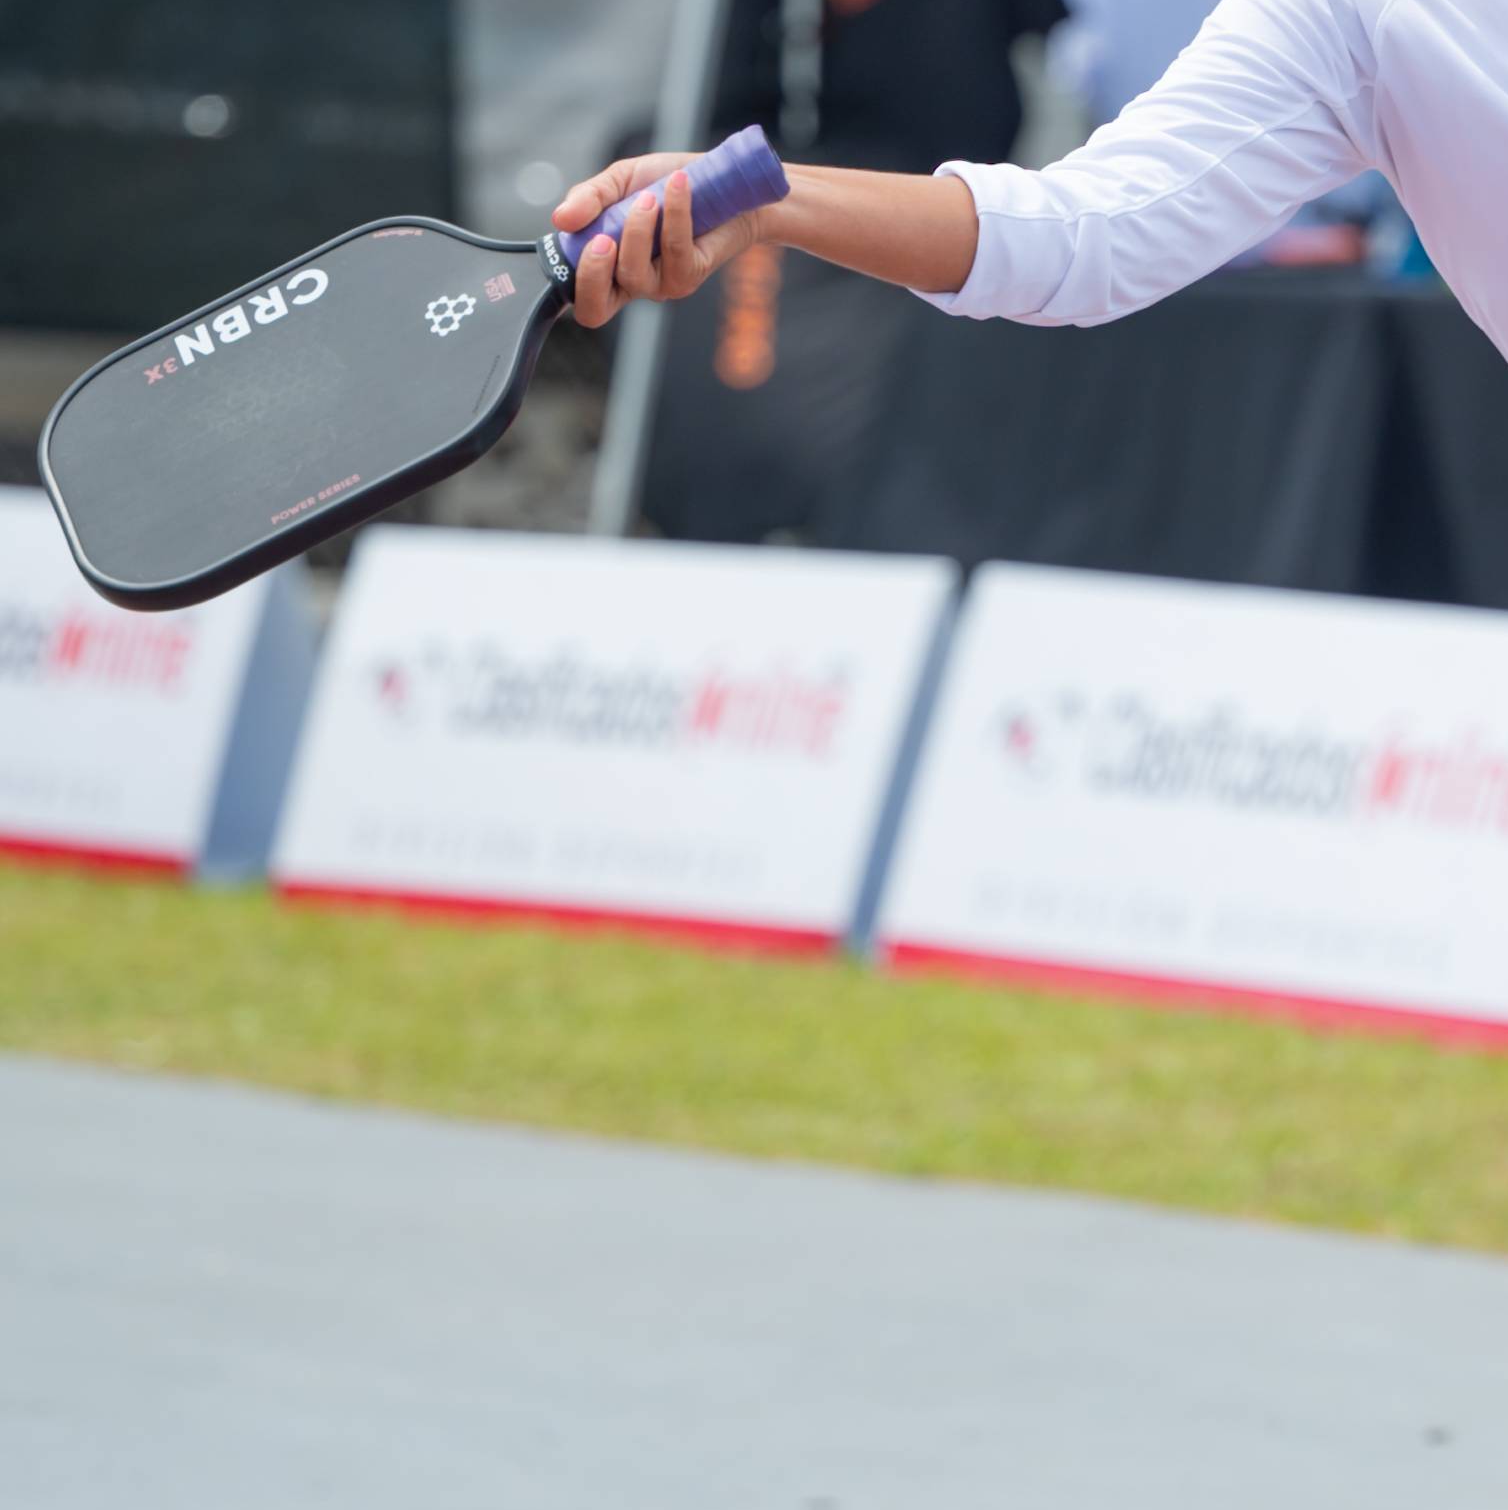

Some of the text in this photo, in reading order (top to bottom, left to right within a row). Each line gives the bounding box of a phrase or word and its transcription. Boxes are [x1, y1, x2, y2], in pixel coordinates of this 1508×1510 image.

[543, 233, 560, 265] CRBN
[143, 268, 329, 385] CRBN 3X
[271, 474, 361, 525] POWER SERIES
